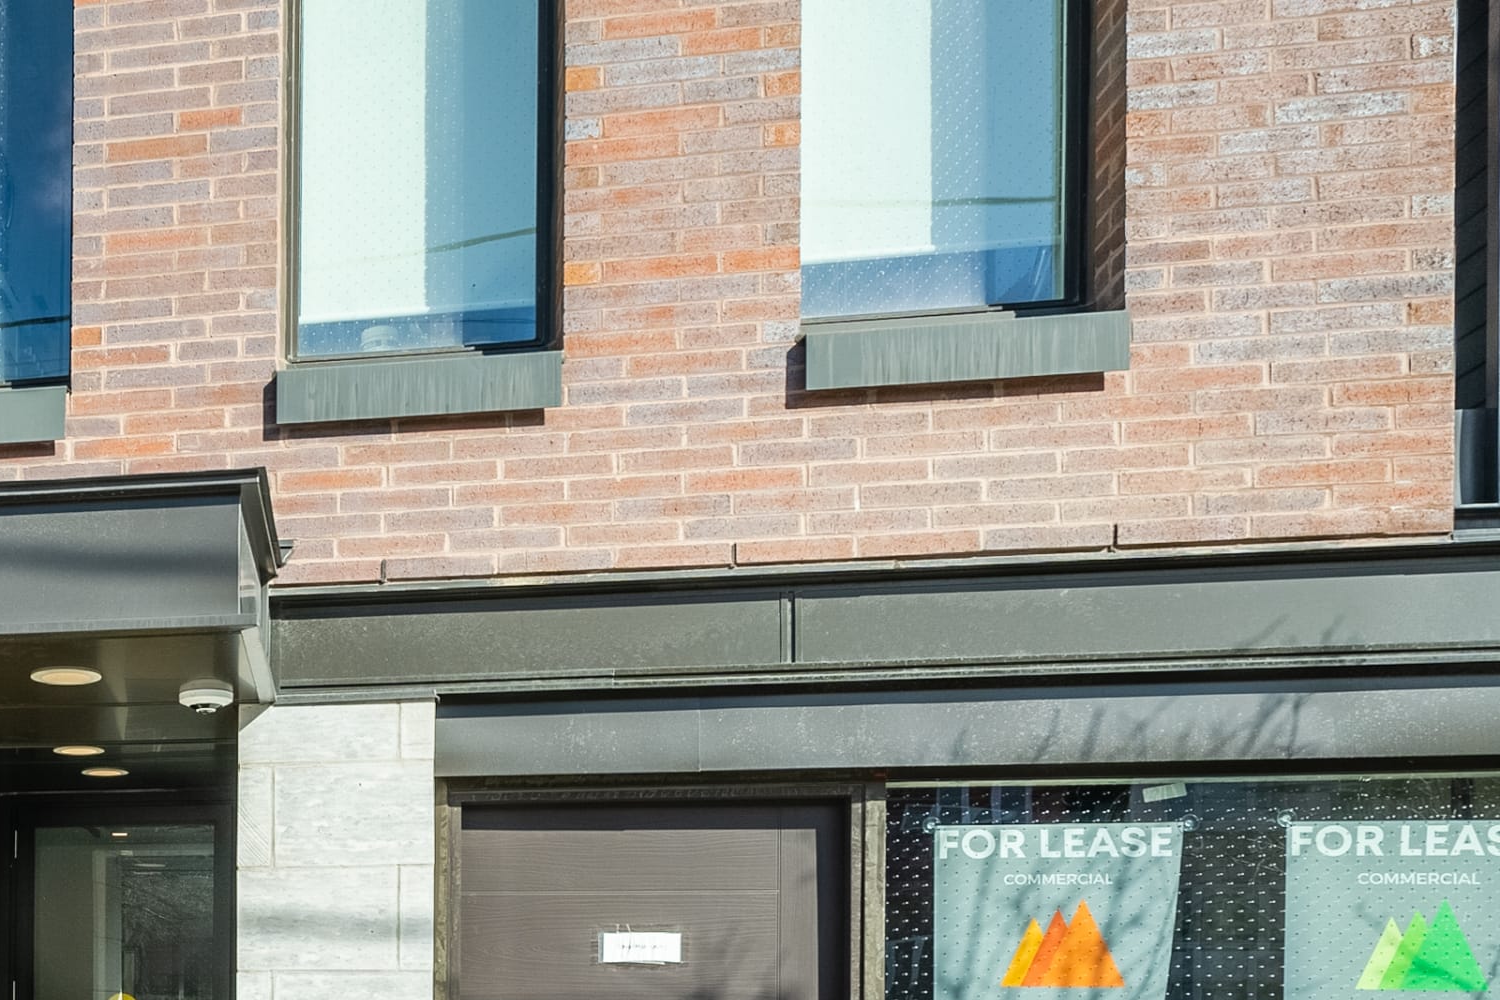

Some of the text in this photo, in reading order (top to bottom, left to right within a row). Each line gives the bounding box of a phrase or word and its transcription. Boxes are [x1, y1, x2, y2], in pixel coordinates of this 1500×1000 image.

[939, 827, 1173, 860] FOR LEASE
[1291, 825, 1384, 857] FOR
[1003, 873, 1113, 886] COMMERCIAL
[1358, 873, 1481, 886] COMMERCIAL
